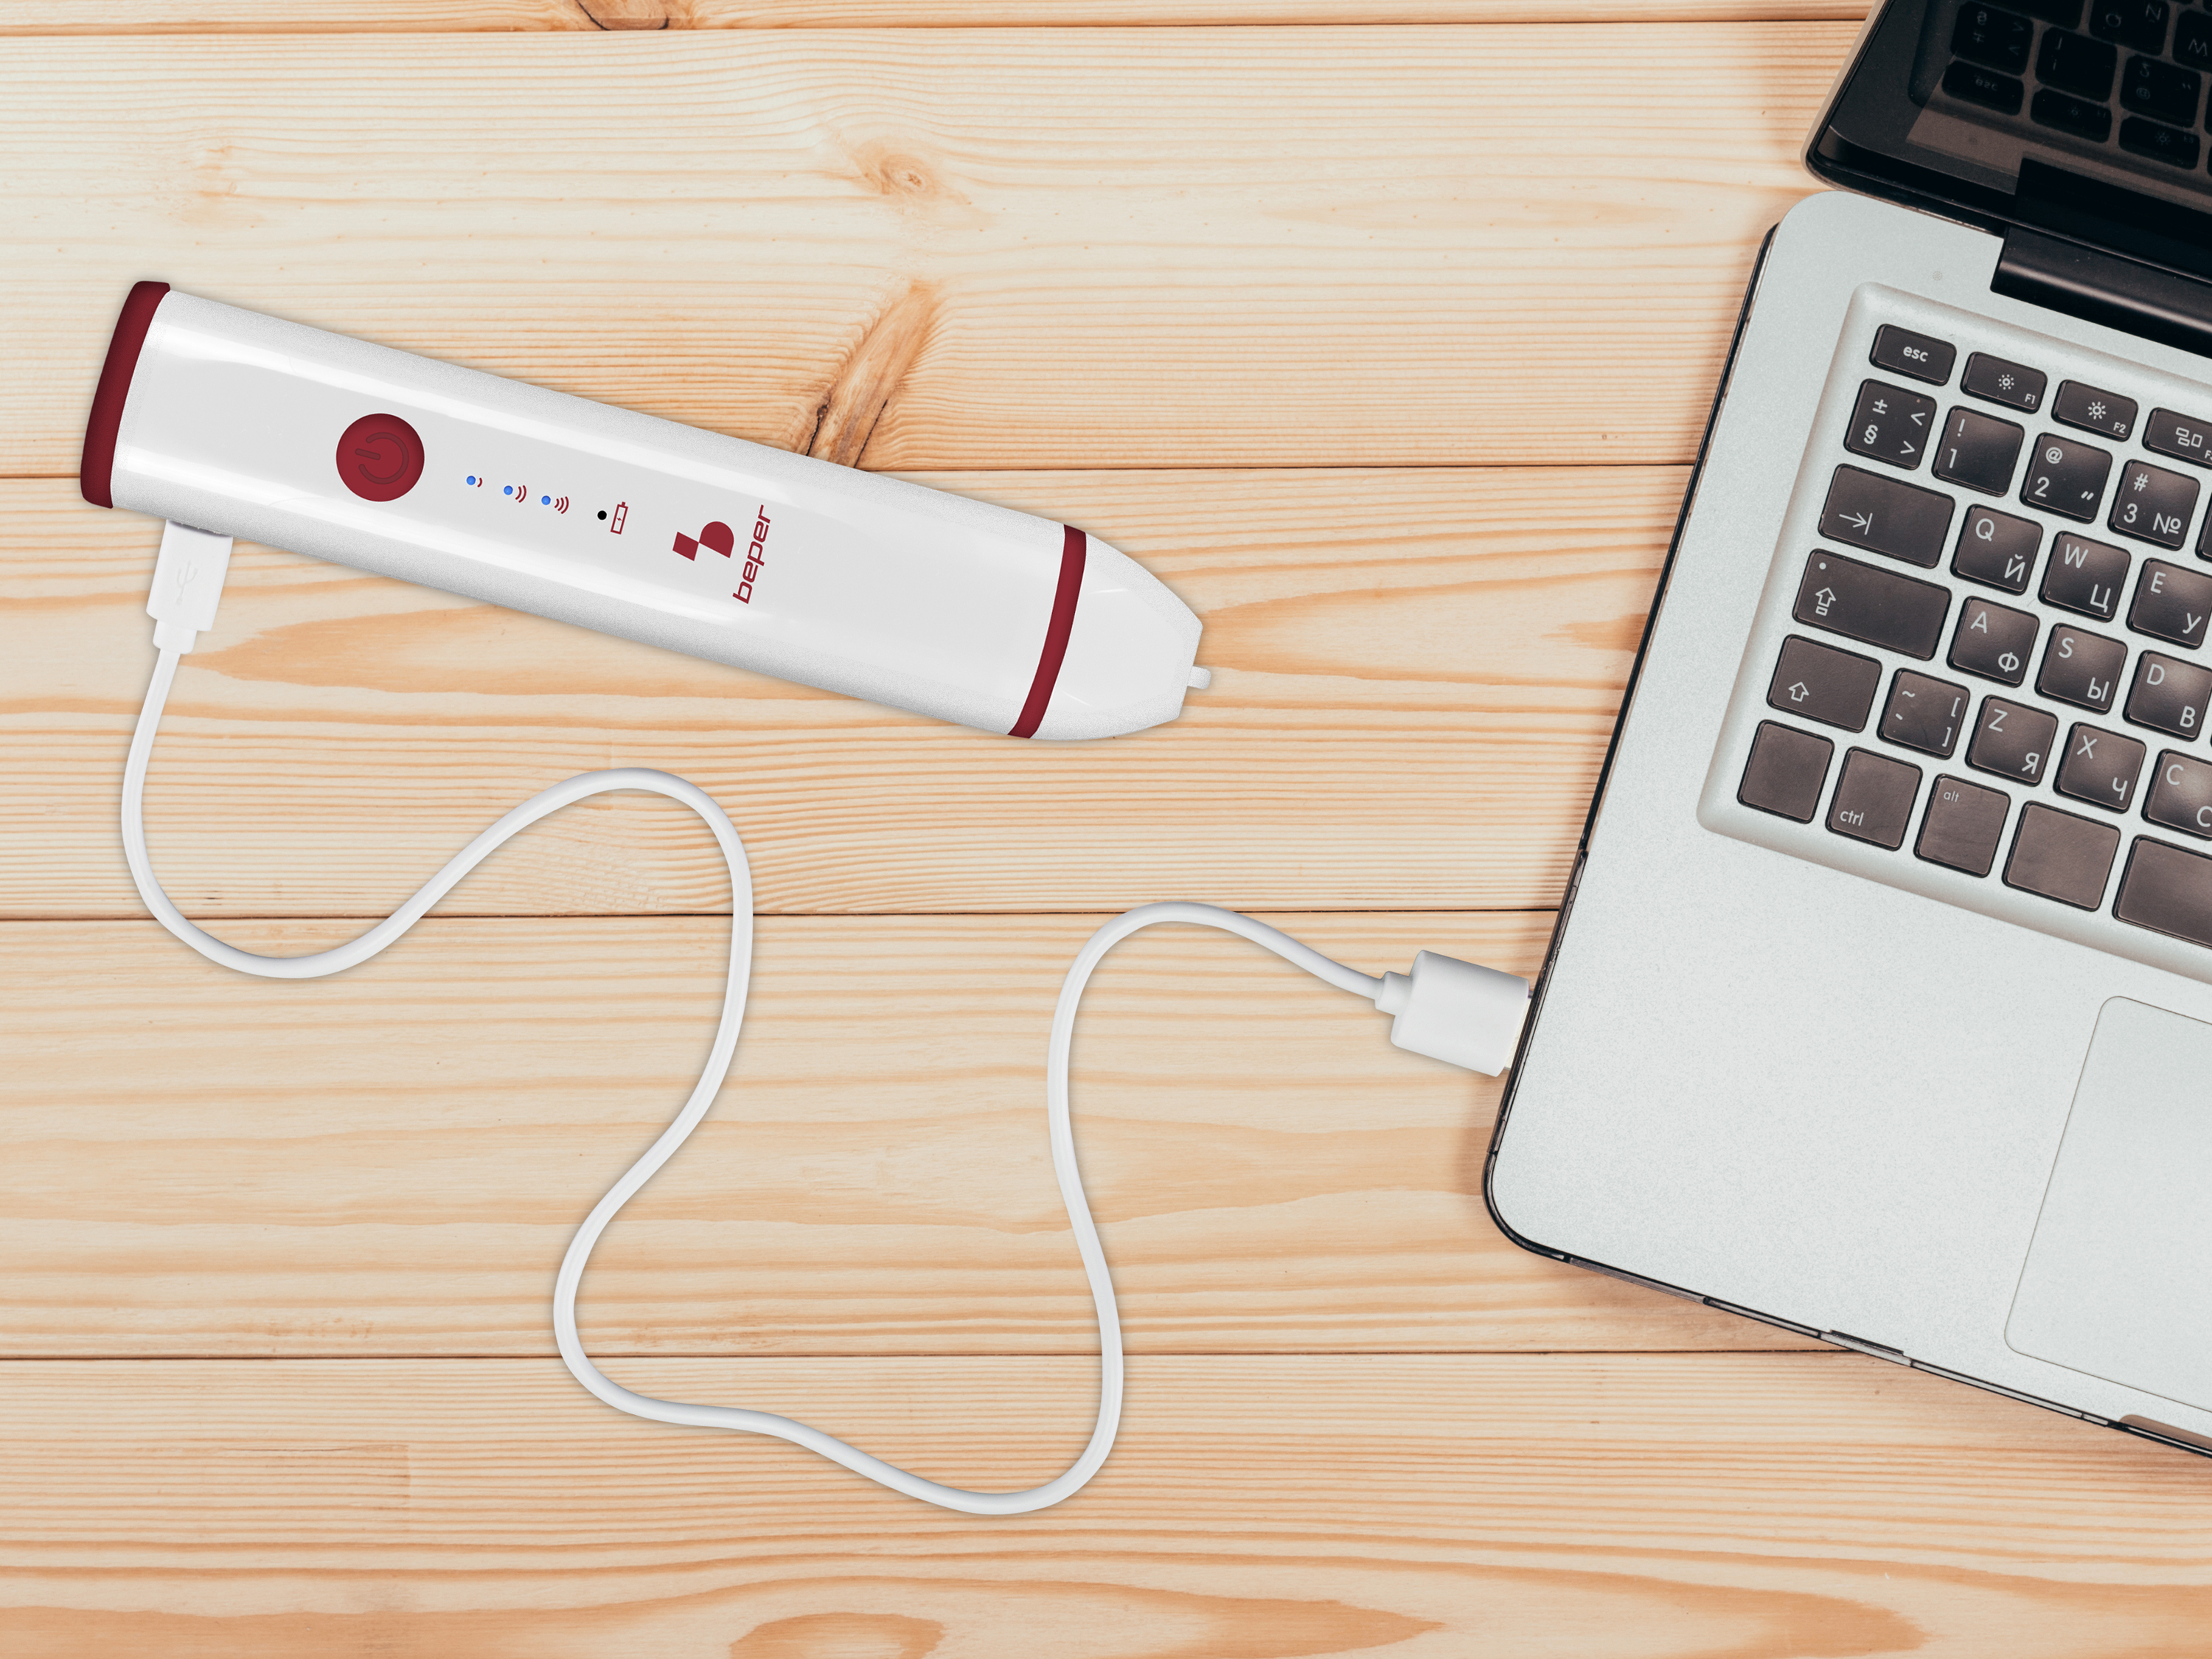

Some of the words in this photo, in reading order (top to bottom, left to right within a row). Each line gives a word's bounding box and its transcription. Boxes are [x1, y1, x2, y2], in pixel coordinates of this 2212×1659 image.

[1903, 346, 1929, 362] esc
[2024, 393, 2036, 404] F1
[2113, 422, 2126, 434] F2
[1949, 448, 1958, 469] 1
[2034, 476, 2050, 498] 2
[2124, 503, 2138, 524] 3
[1975, 518, 1994, 542] Q
[732, 504, 771, 605] beper
[2065, 543, 2089, 568] W
[2150, 571, 2166, 594] E
[1970, 611, 1987, 634] A
[2058, 637, 2075, 658] S
[2146, 663, 2166, 686] D
[1988, 709, 2008, 732] Z
[2076, 734, 2098, 759] X
[2166, 764, 2184, 786] C
[1943, 790, 1959, 803] alt
[1840, 810, 1864, 827] ctrl
